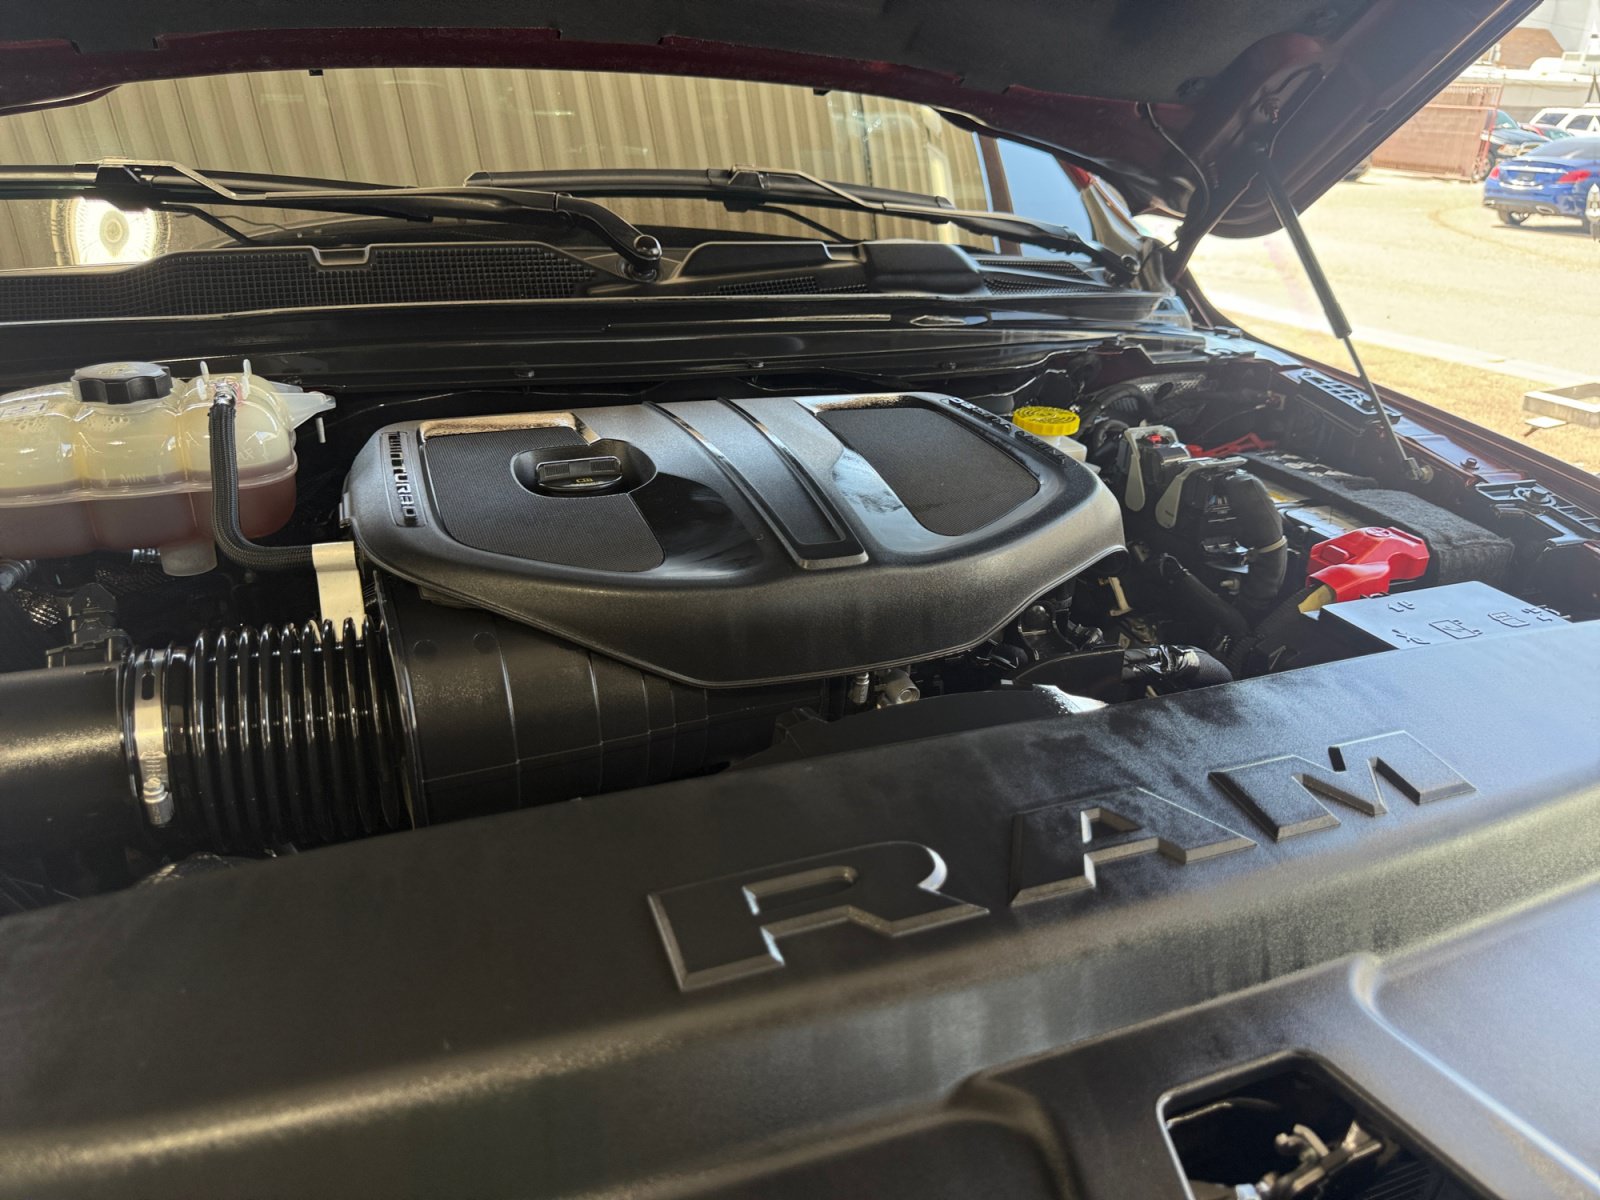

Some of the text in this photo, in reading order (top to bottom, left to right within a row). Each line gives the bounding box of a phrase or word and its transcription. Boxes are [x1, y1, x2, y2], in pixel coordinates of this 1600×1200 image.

[119, 472, 146, 484] MIN
[391, 463, 417, 518] TURBO
[646, 729, 1478, 992] RAM
